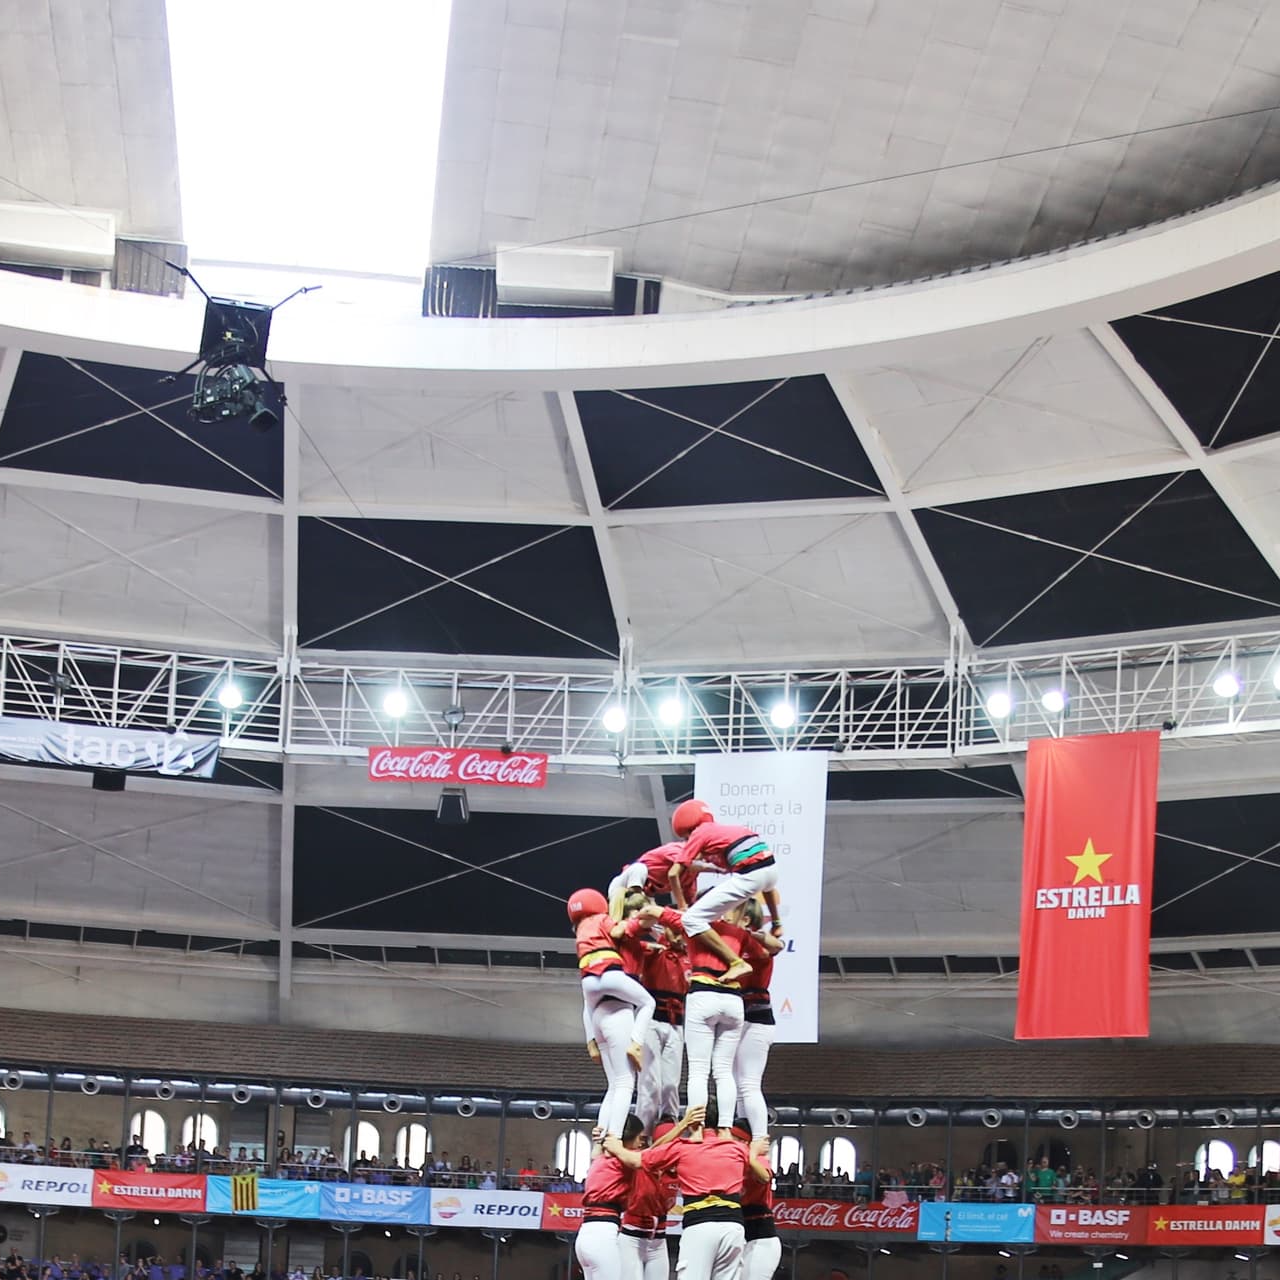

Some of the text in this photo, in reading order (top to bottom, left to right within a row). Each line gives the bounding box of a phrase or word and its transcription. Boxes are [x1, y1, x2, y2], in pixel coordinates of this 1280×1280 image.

[371, 750, 544, 784] Coca-Cola Coca-Cola
[720, 783, 776, 797] Donem
[720, 800, 802, 818] suport a la
[1036, 884, 1140, 909] ESTRELLA
[1067, 907, 1105, 919] DAMM
[21, 1179, 89, 1194] REPSOL
[113, 1185, 202, 1199] ESTRELLA DAMM
[362, 1187, 413, 1205] BASF
[473, 1203, 539, 1218] REPSOL
[772, 1201, 918, 1230] Coca-Cola Coca-Cola
[1078, 1210, 1130, 1226] BASF
[1170, 1220, 1261, 1231] ESTRELLA DAMM
[1049, 1230, 1129, 1241] We create chemistry
